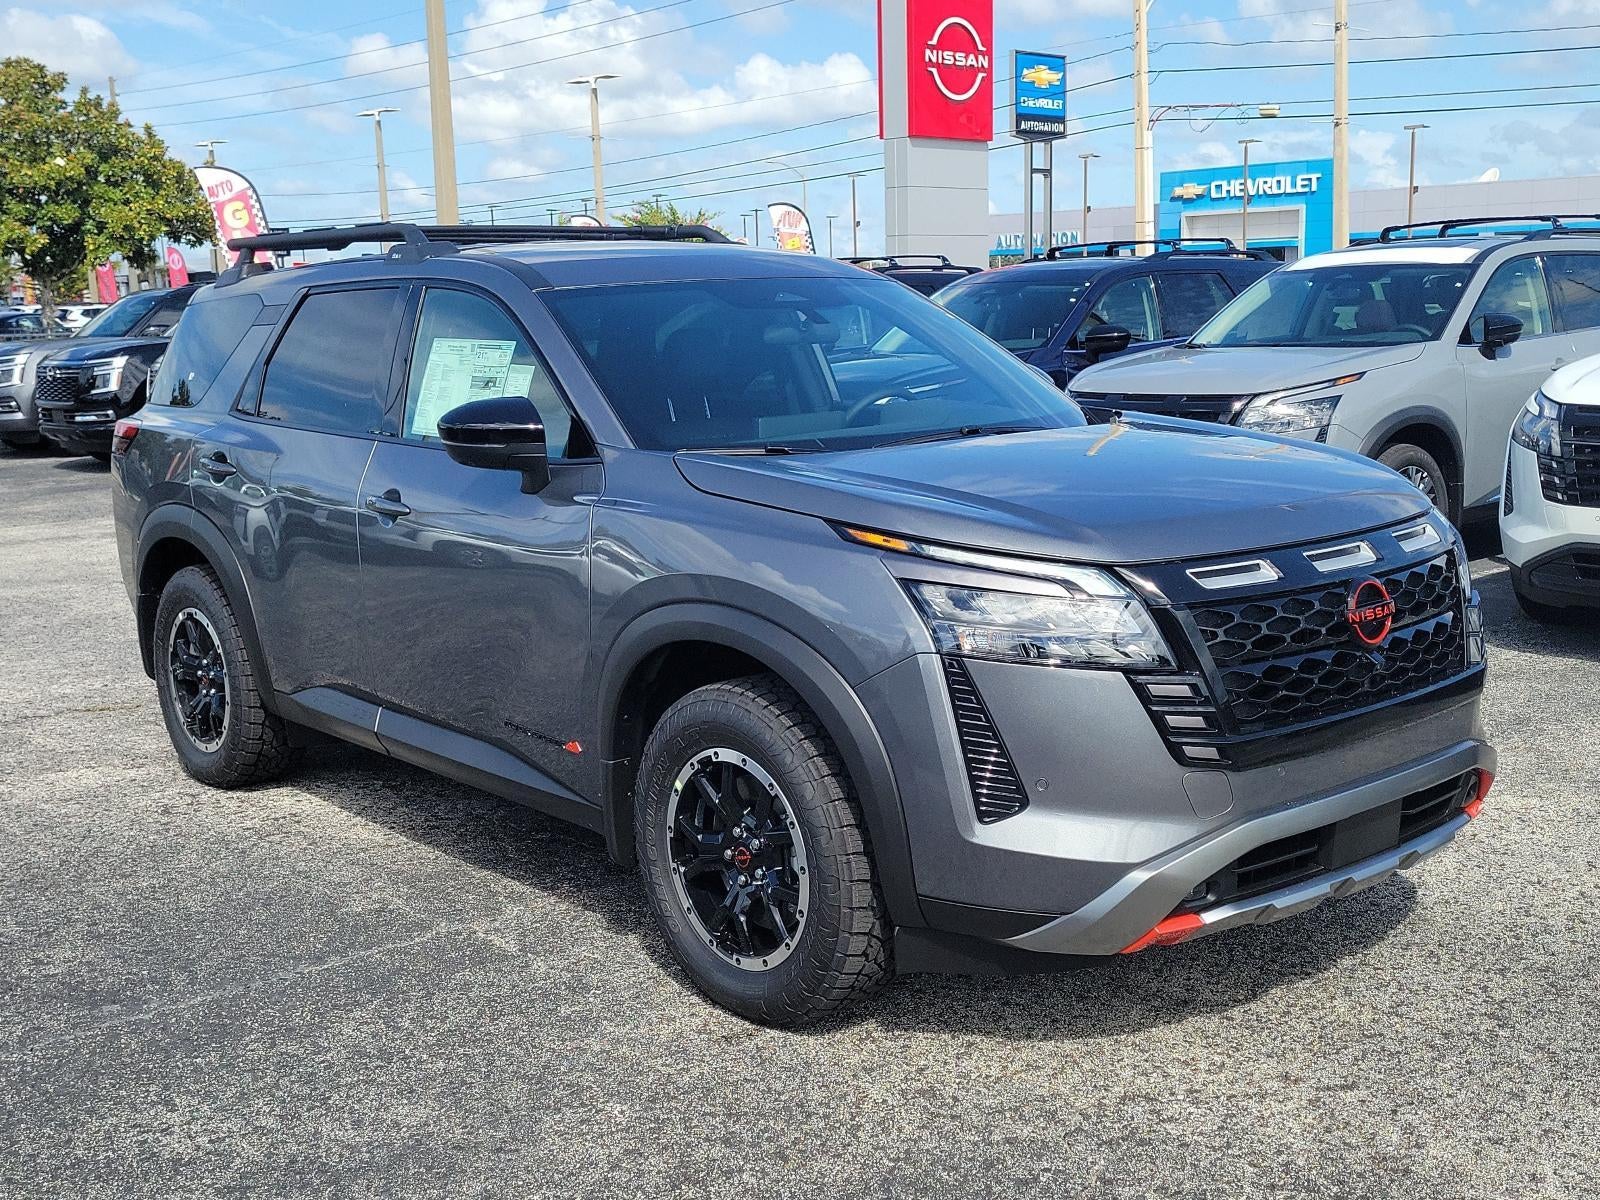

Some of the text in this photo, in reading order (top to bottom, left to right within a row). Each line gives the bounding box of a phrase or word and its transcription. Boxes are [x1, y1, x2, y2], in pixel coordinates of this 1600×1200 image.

[925, 49, 988, 68] NISSAN
[1020, 96, 1064, 110] CHEVROLET
[1020, 120, 1064, 133] AUTONATION
[207, 180, 233, 199] AUTO
[1210, 174, 1322, 199] CHEVROLET
[1348, 602, 1396, 623] NISSAN
